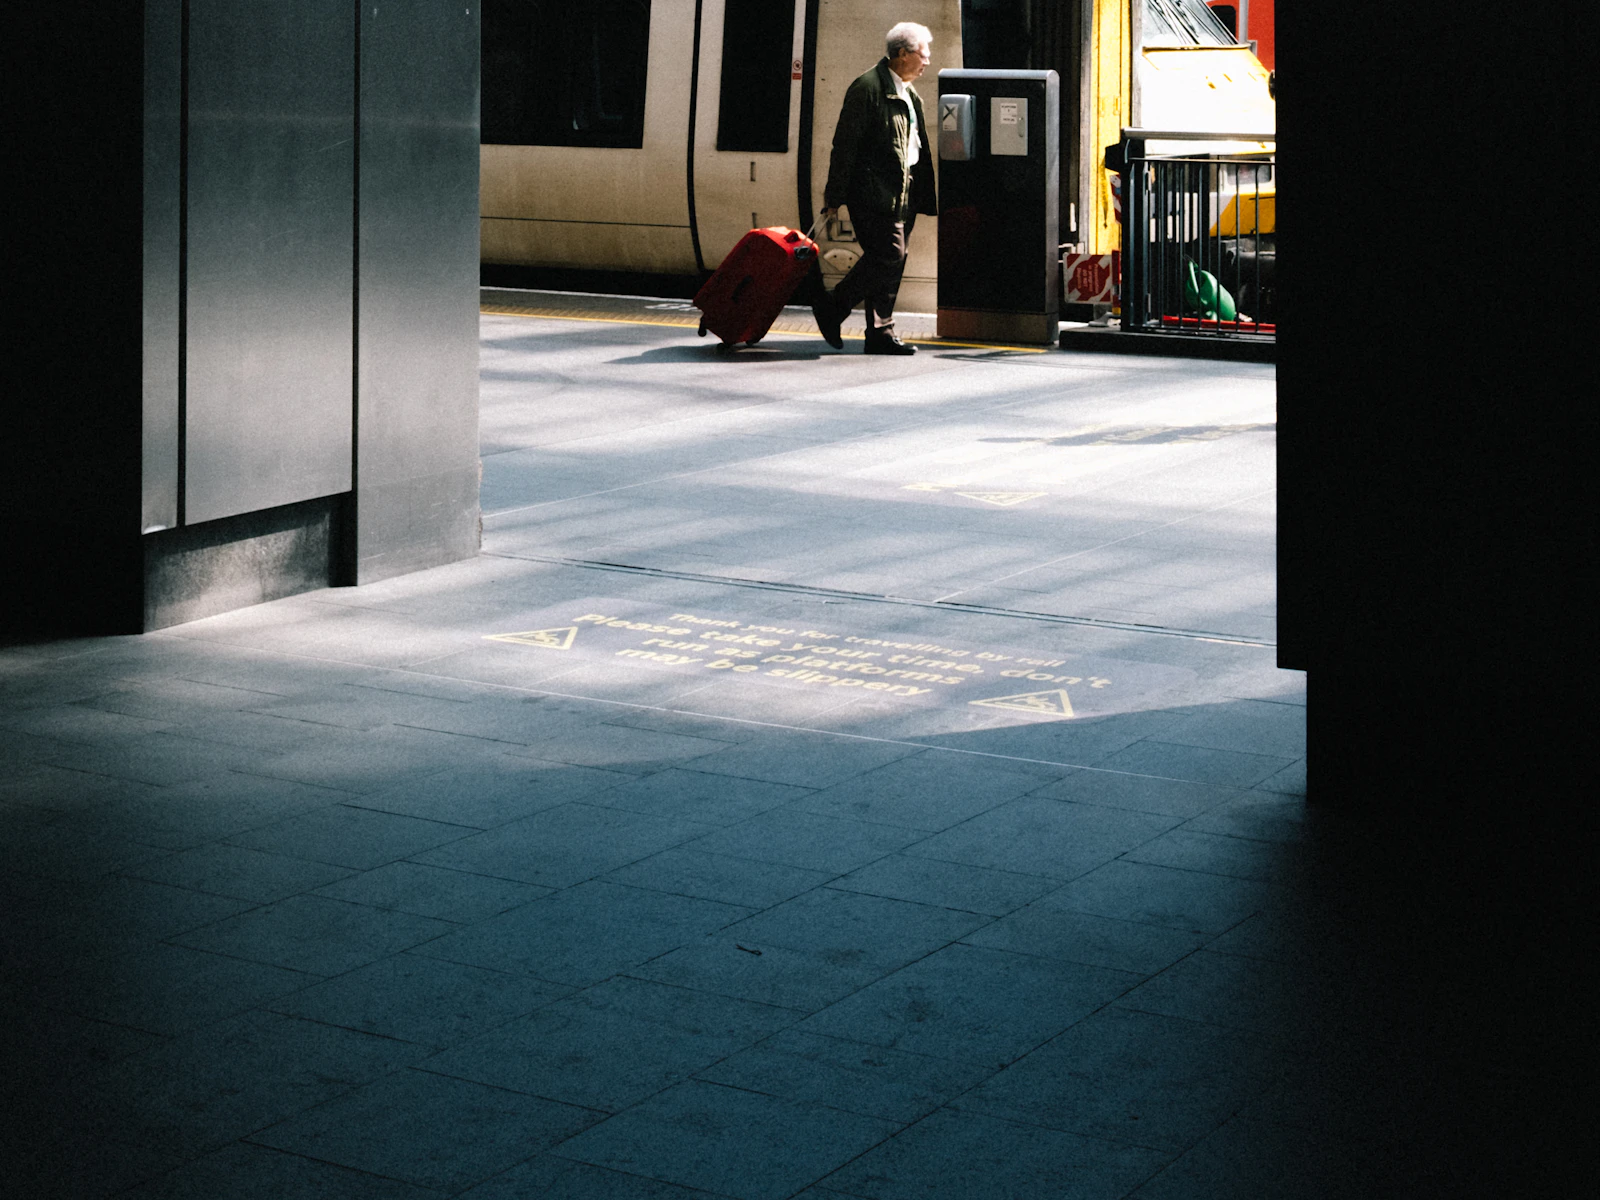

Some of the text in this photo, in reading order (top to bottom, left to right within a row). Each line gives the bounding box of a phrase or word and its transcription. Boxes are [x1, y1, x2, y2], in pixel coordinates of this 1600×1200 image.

[571, 613, 692, 636] Please
[699, 631, 782, 647] take
[780, 643, 882, 659] your
[1000, 669, 1112, 689] don't
[641, 638, 965, 685] run as platforms
[669, 613, 1067, 668] Thank you for travelling by rail
[615, 648, 934, 696] may be slippery
